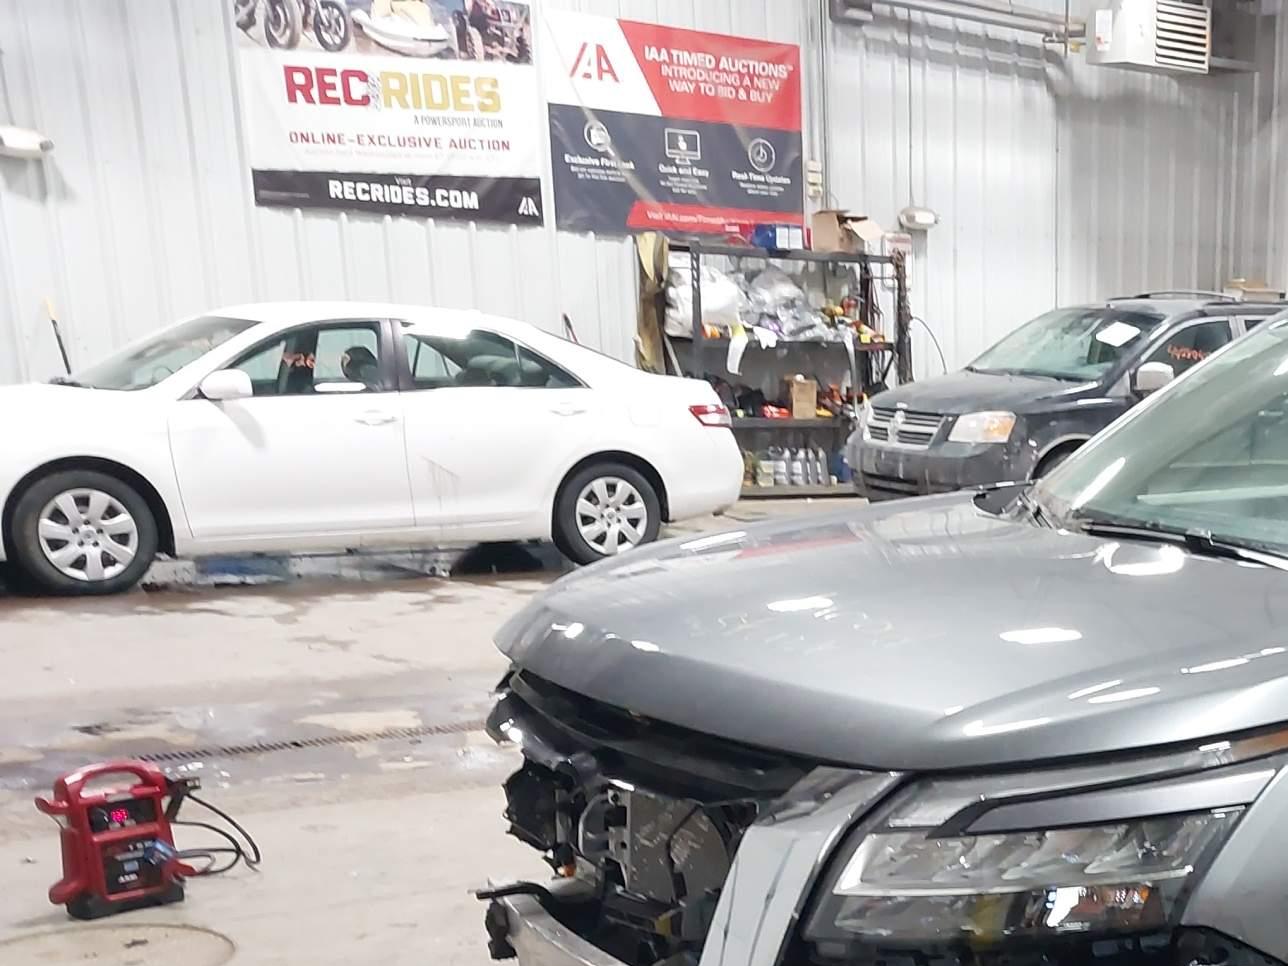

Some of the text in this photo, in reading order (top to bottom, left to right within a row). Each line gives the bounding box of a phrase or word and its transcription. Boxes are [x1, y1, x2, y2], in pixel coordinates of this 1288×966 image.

[645, 45, 669, 63] IAA
[670, 50, 716, 70] TIMED
[283, 64, 503, 113] REC RIDES
[661, 64, 780, 91] INTRODUCING A NEW
[668, 79, 696, 94] WAY
[699, 82, 716, 98] TO
[737, 88, 748, 102] &
[750, 90, 774, 104] BUY
[421, 115, 472, 128] POWERSPORT
[472, 117, 504, 130] AUCTION
[289, 131, 511, 151] ONLINE-EXCLUSIVE AUCTION
[328, 179, 480, 210] RECRIDES.COM
